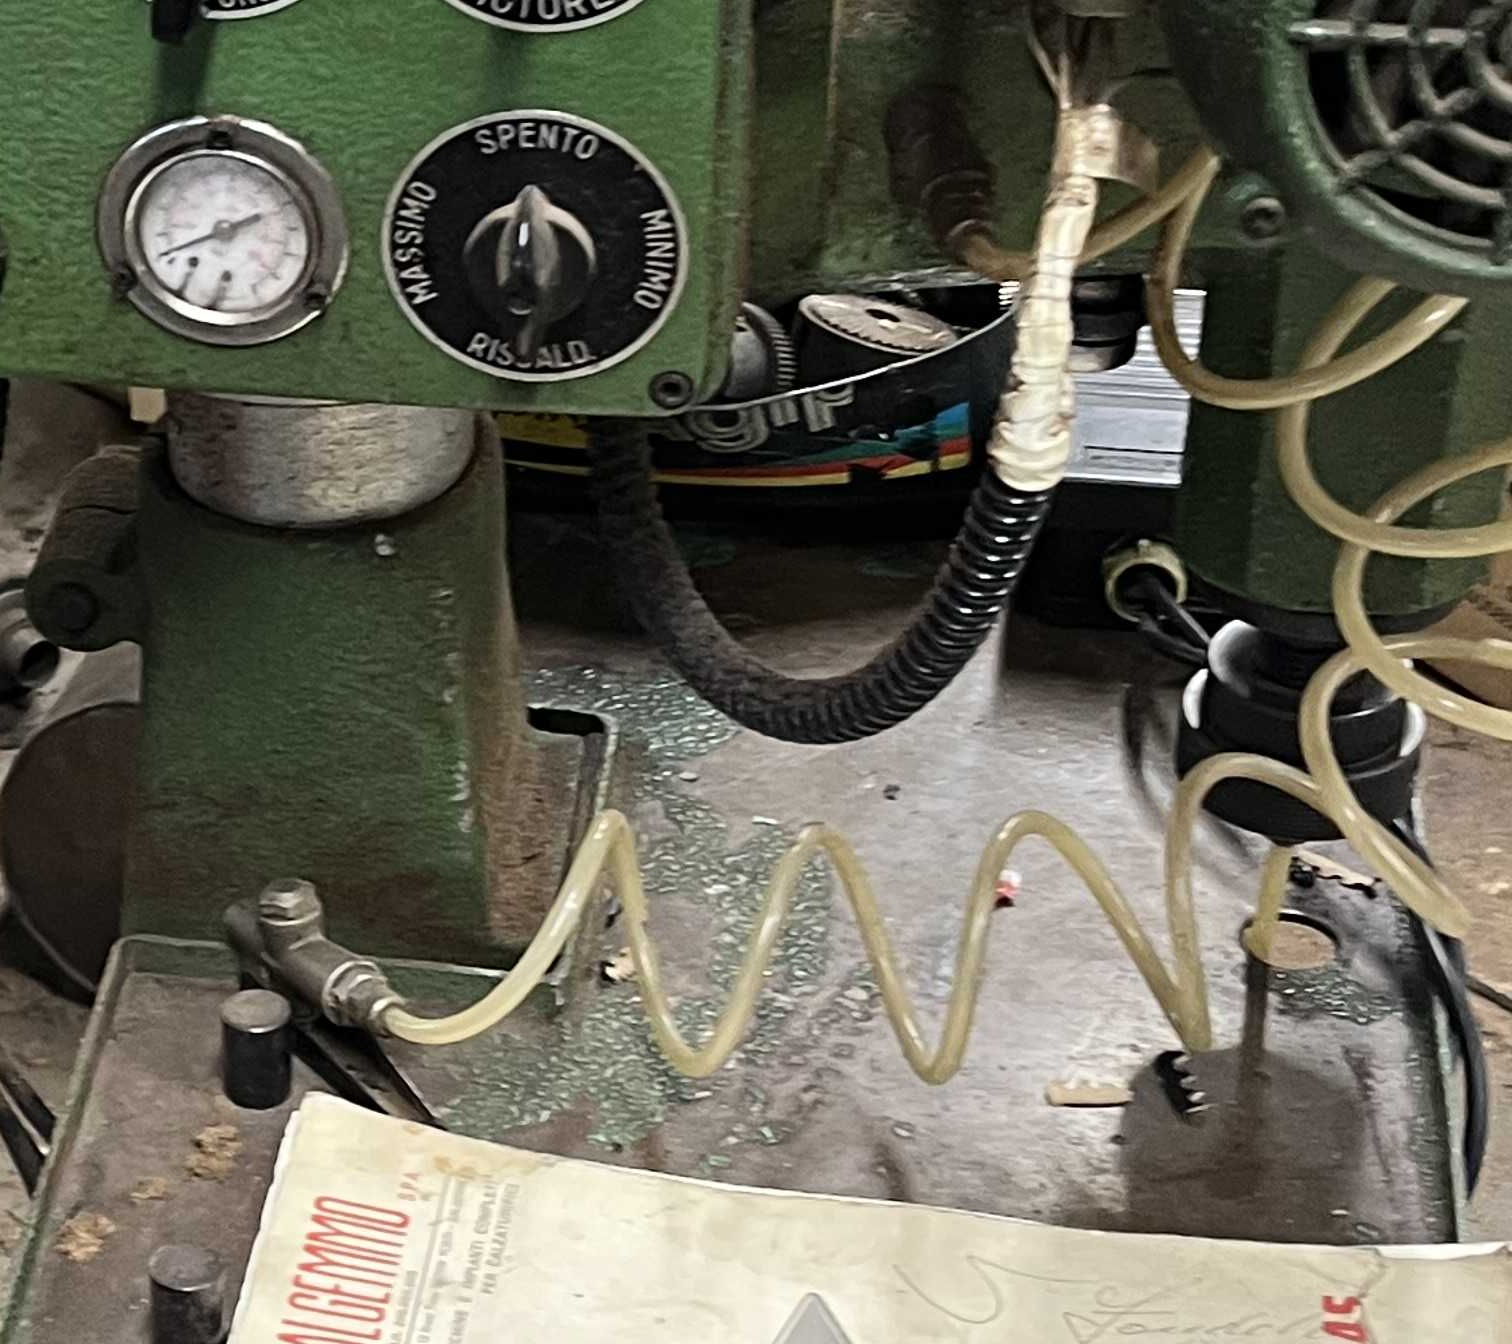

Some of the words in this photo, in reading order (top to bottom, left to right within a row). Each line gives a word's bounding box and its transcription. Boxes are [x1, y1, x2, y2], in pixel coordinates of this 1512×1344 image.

[474, 123, 599, 160] SPENTO
[391, 181, 438, 306] MASSIMO
[633, 209, 676, 311] MINIMO
[467, 332, 597, 369] RISALD.
